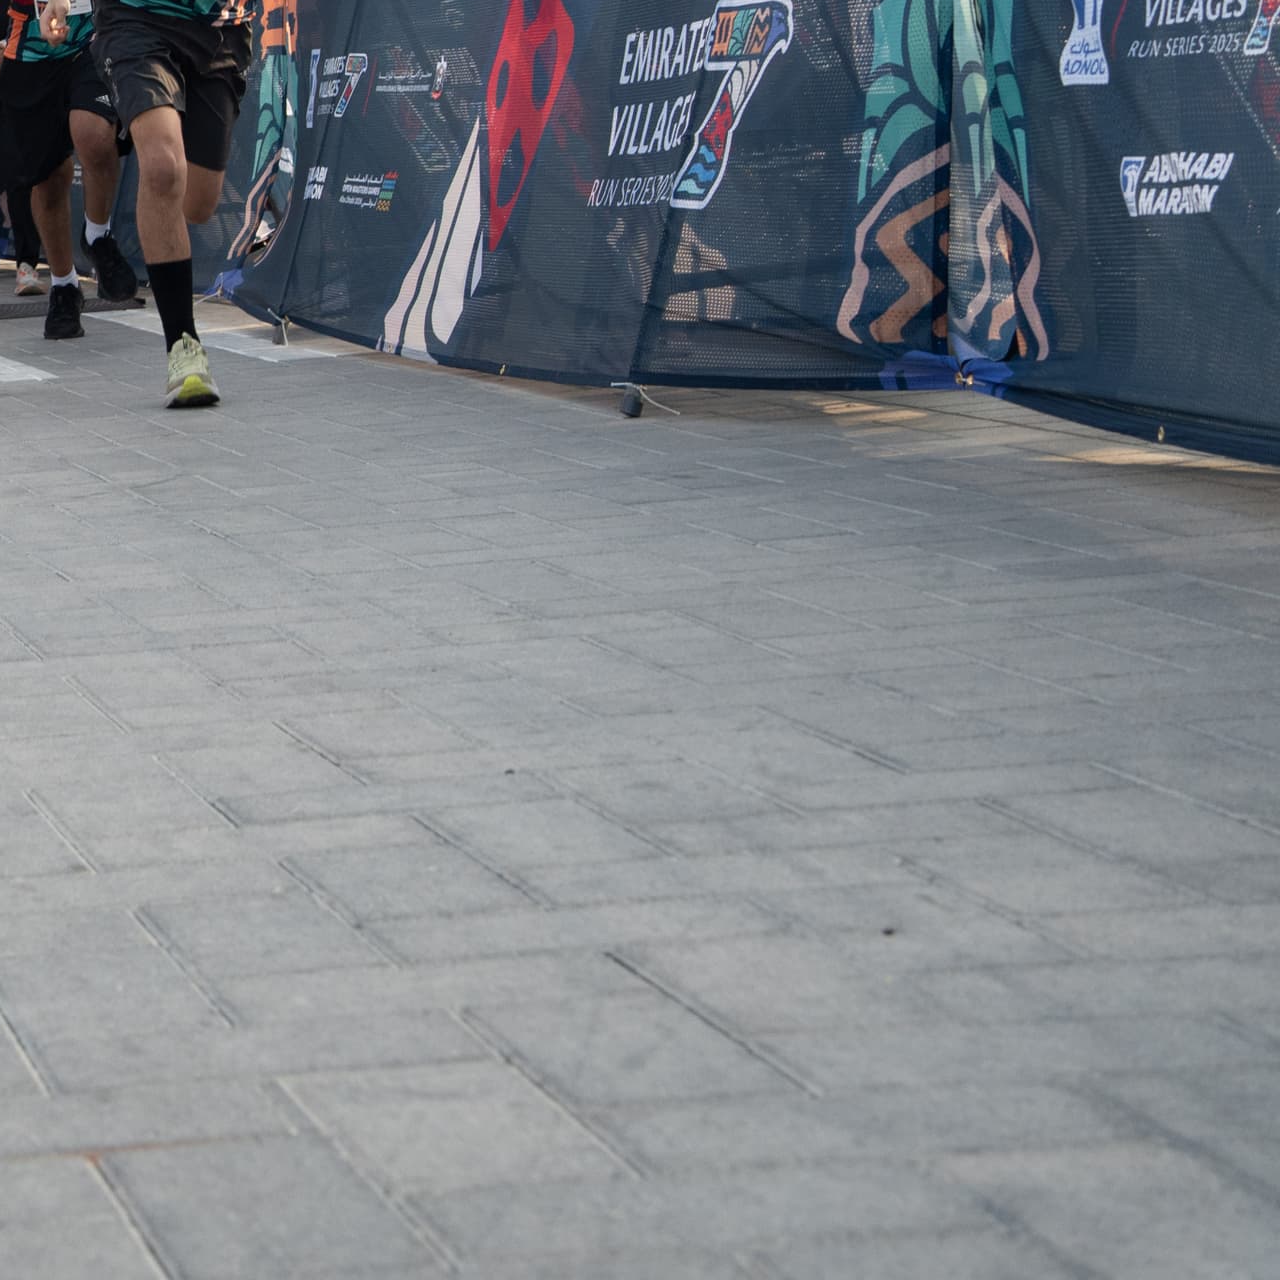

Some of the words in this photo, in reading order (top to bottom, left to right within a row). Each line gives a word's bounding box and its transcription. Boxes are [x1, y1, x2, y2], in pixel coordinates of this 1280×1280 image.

[619, 16, 710, 85] EMIRATE
[1127, 40, 1161, 57] RUN
[1163, 35, 1205, 56] SERIES
[1207, 33, 1241, 53] 2025
[1063, 57, 1105, 76] ADNOC
[587, 178, 621, 207] RUN
